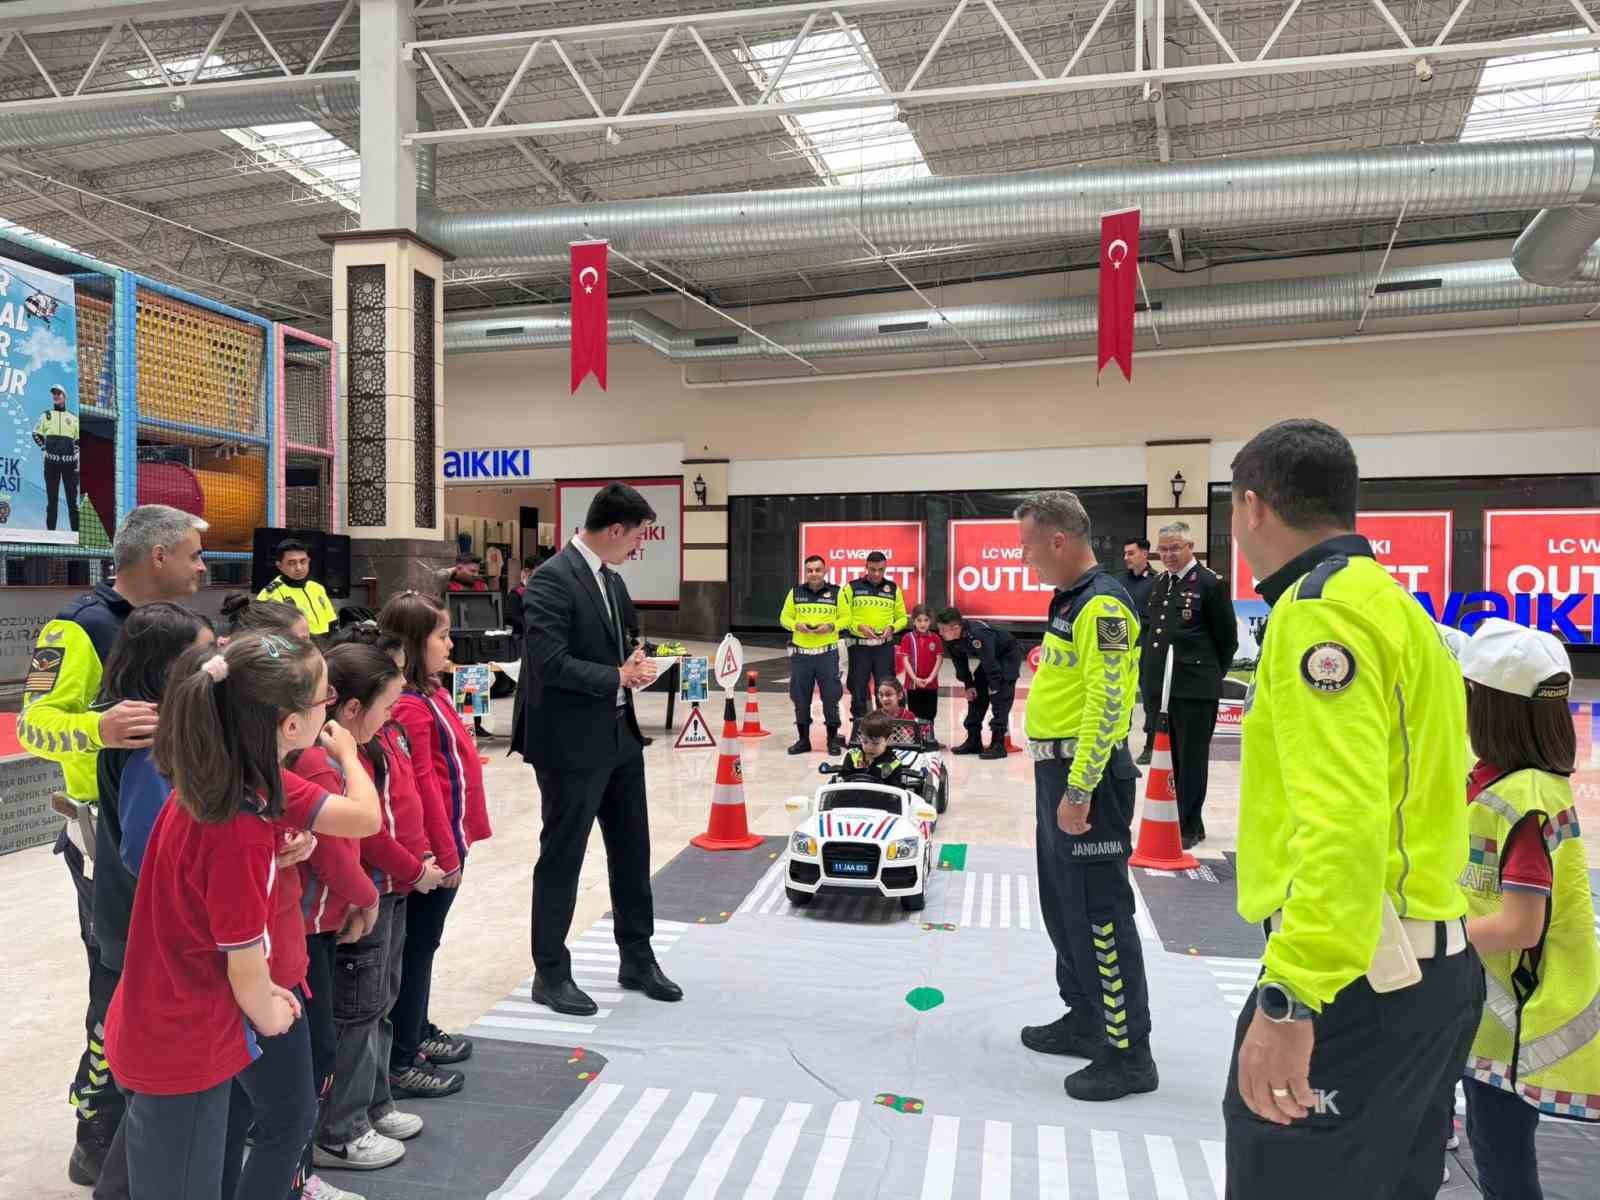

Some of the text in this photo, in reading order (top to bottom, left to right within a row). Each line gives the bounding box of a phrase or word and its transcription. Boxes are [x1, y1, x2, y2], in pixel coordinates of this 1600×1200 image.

[982, 548, 999, 560] LC
[1548, 538, 1577, 554] LC
[829, 549, 845, 560] LC
[823, 566, 915, 591] UTET
[1072, 841, 1123, 857] JANDARMA
